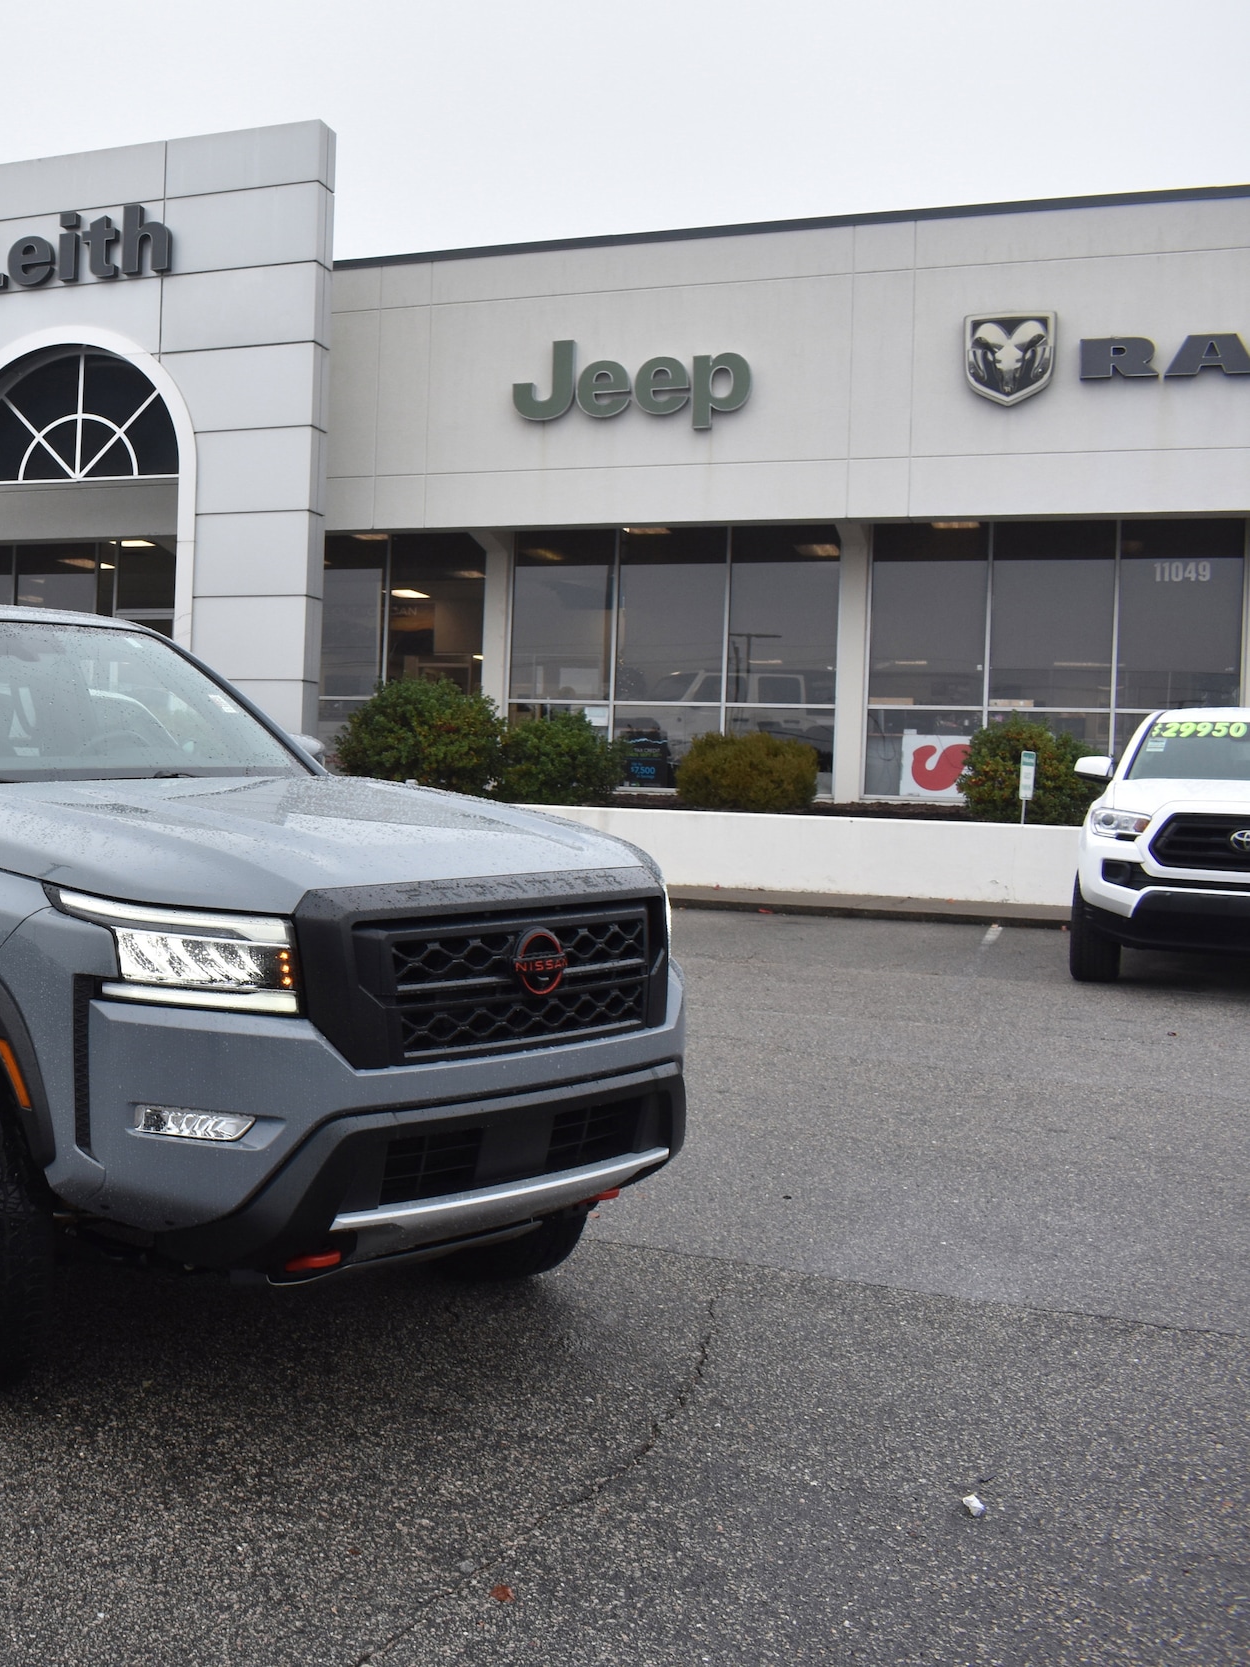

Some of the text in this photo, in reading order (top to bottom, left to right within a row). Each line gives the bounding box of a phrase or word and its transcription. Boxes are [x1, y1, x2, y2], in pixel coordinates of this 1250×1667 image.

[512, 339, 753, 430] Jeep
[1153, 560, 1211, 582] 11049
[1151, 721, 1248, 738] $29950
[631, 766, 656, 775] $7,500
[515, 957, 567, 972] NISSAN
